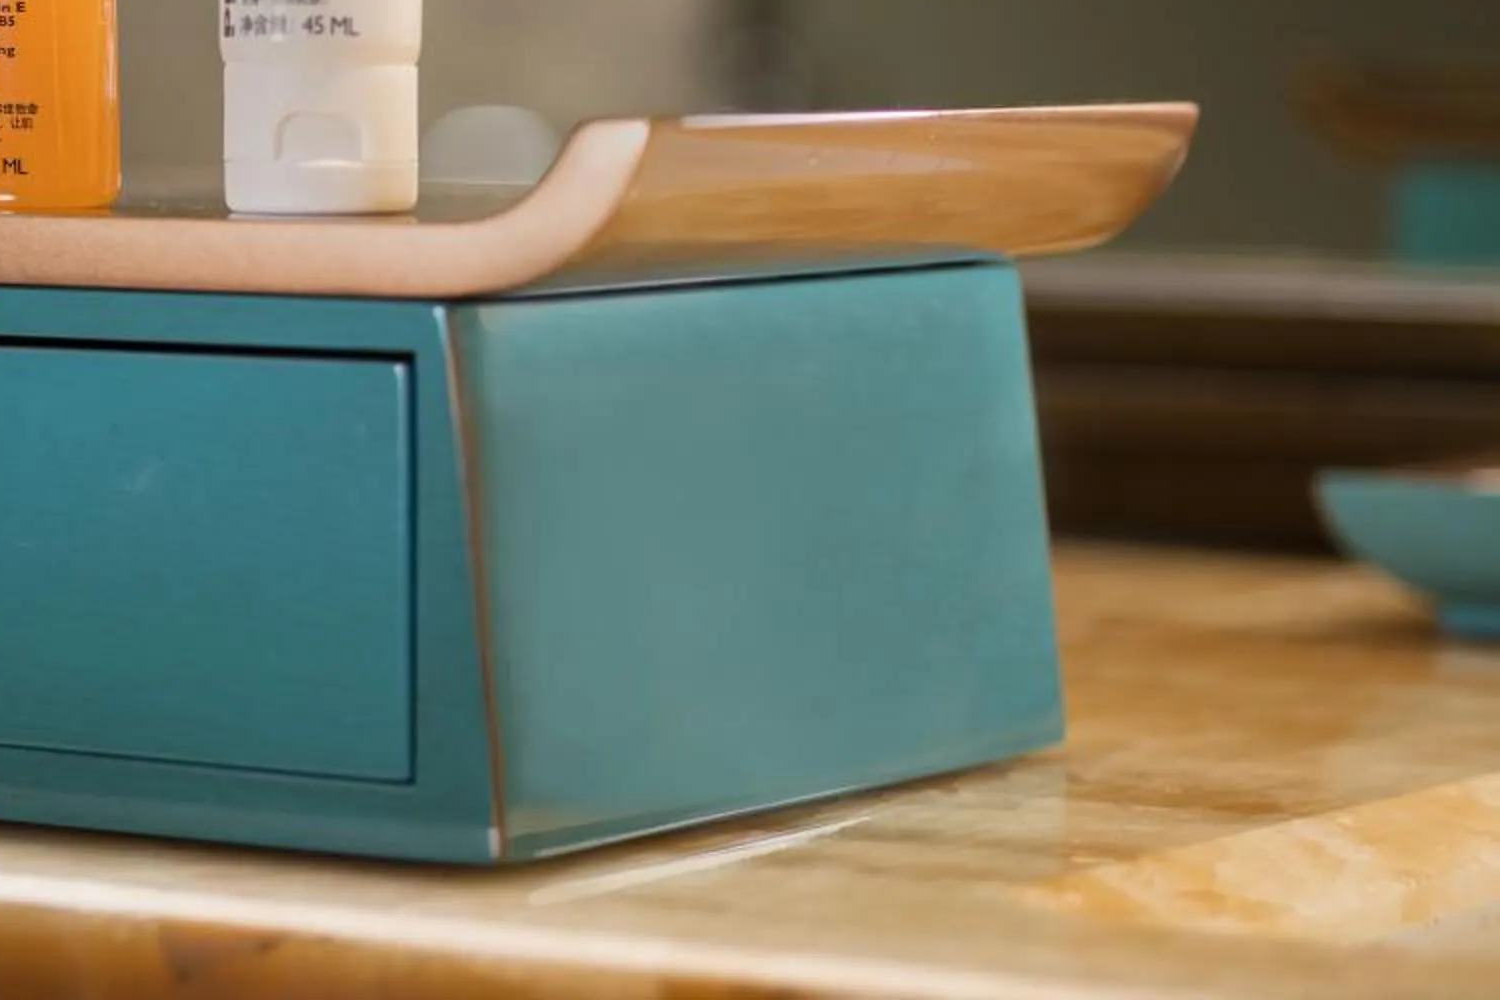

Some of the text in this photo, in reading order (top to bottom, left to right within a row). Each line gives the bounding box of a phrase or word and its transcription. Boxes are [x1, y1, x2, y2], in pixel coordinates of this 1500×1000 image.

[16, 2, 26, 12] E
[301, 15, 324, 35] 45
[330, 16, 360, 36] ML
[3, 159, 28, 174] ML
